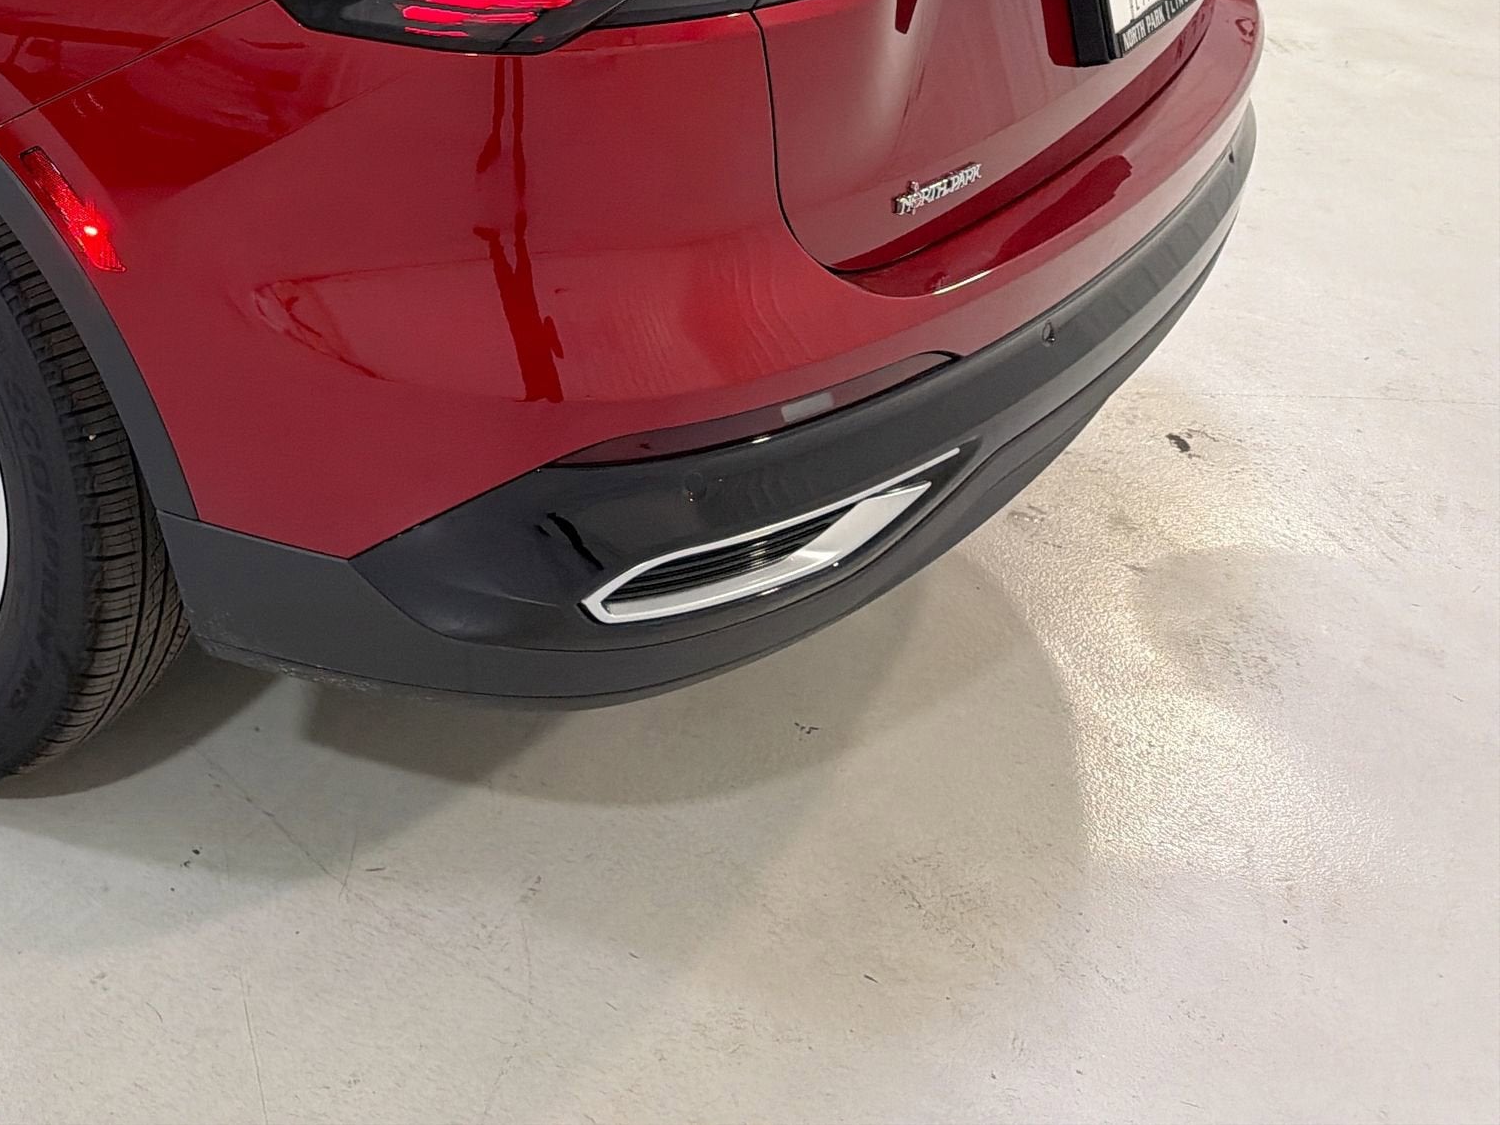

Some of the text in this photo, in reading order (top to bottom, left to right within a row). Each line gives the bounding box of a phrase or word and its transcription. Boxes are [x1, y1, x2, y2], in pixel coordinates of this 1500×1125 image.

[1122, 19, 1147, 52] NORTH
[1145, 5, 1166, 35] PARK
[897, 164, 982, 216] NORTH PARK
